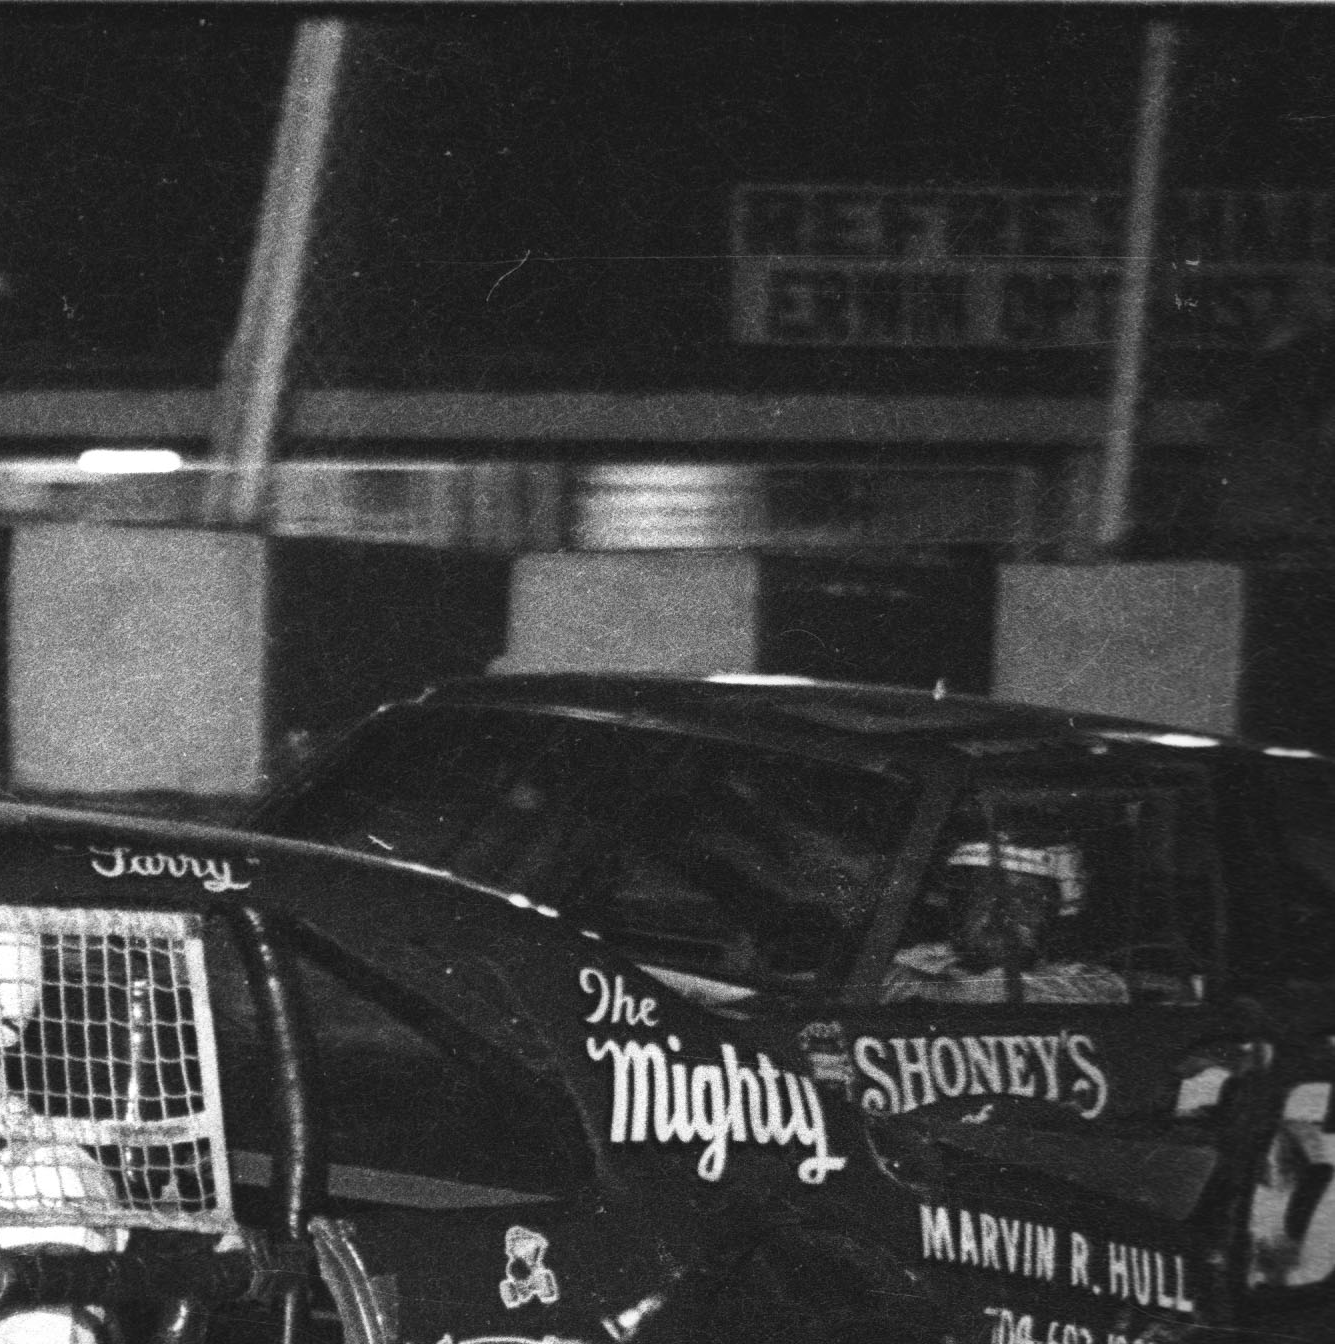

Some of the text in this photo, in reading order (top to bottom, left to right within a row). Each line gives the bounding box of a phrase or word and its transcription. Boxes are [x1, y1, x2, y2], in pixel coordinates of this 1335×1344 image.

[579, 968, 656, 1026] The
[587, 1038, 845, 1184] Mighty
[854, 1029, 1107, 1119] SHONEY'S
[919, 1204, 1194, 1313] MARVIN R. HULL
